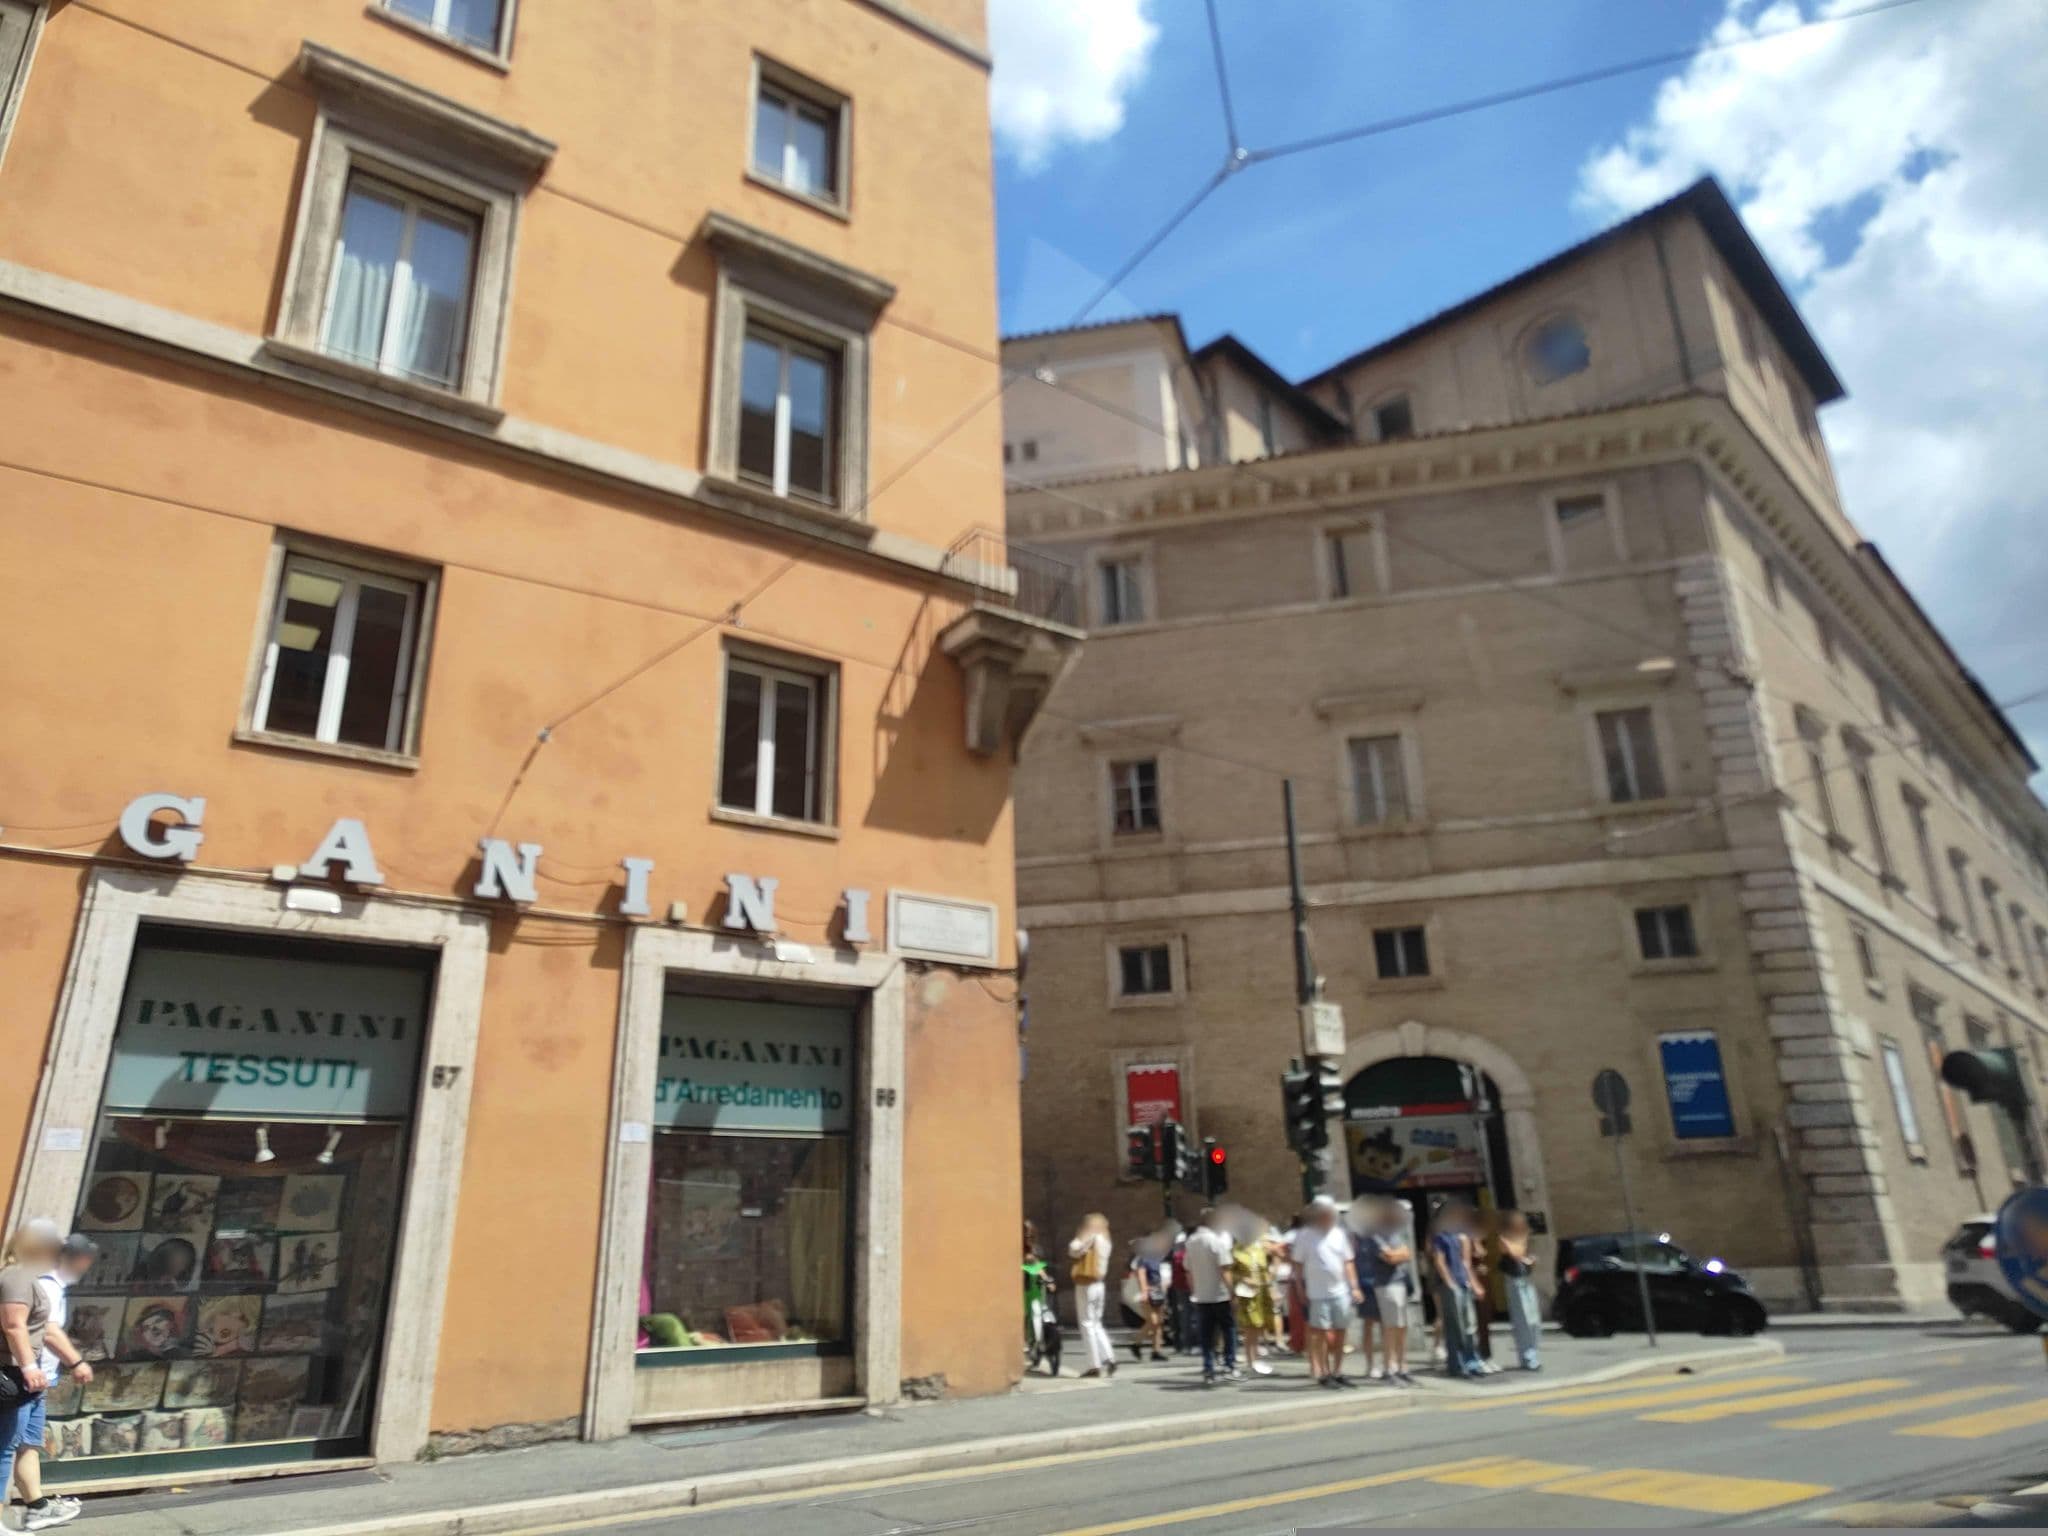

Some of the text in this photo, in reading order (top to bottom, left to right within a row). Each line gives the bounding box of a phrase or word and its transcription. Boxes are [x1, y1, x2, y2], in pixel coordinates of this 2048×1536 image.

[0, 792, 872, 942] GANINI
[137, 998, 408, 1041] PAGANINI
[178, 1051, 360, 1089] TESSUTI
